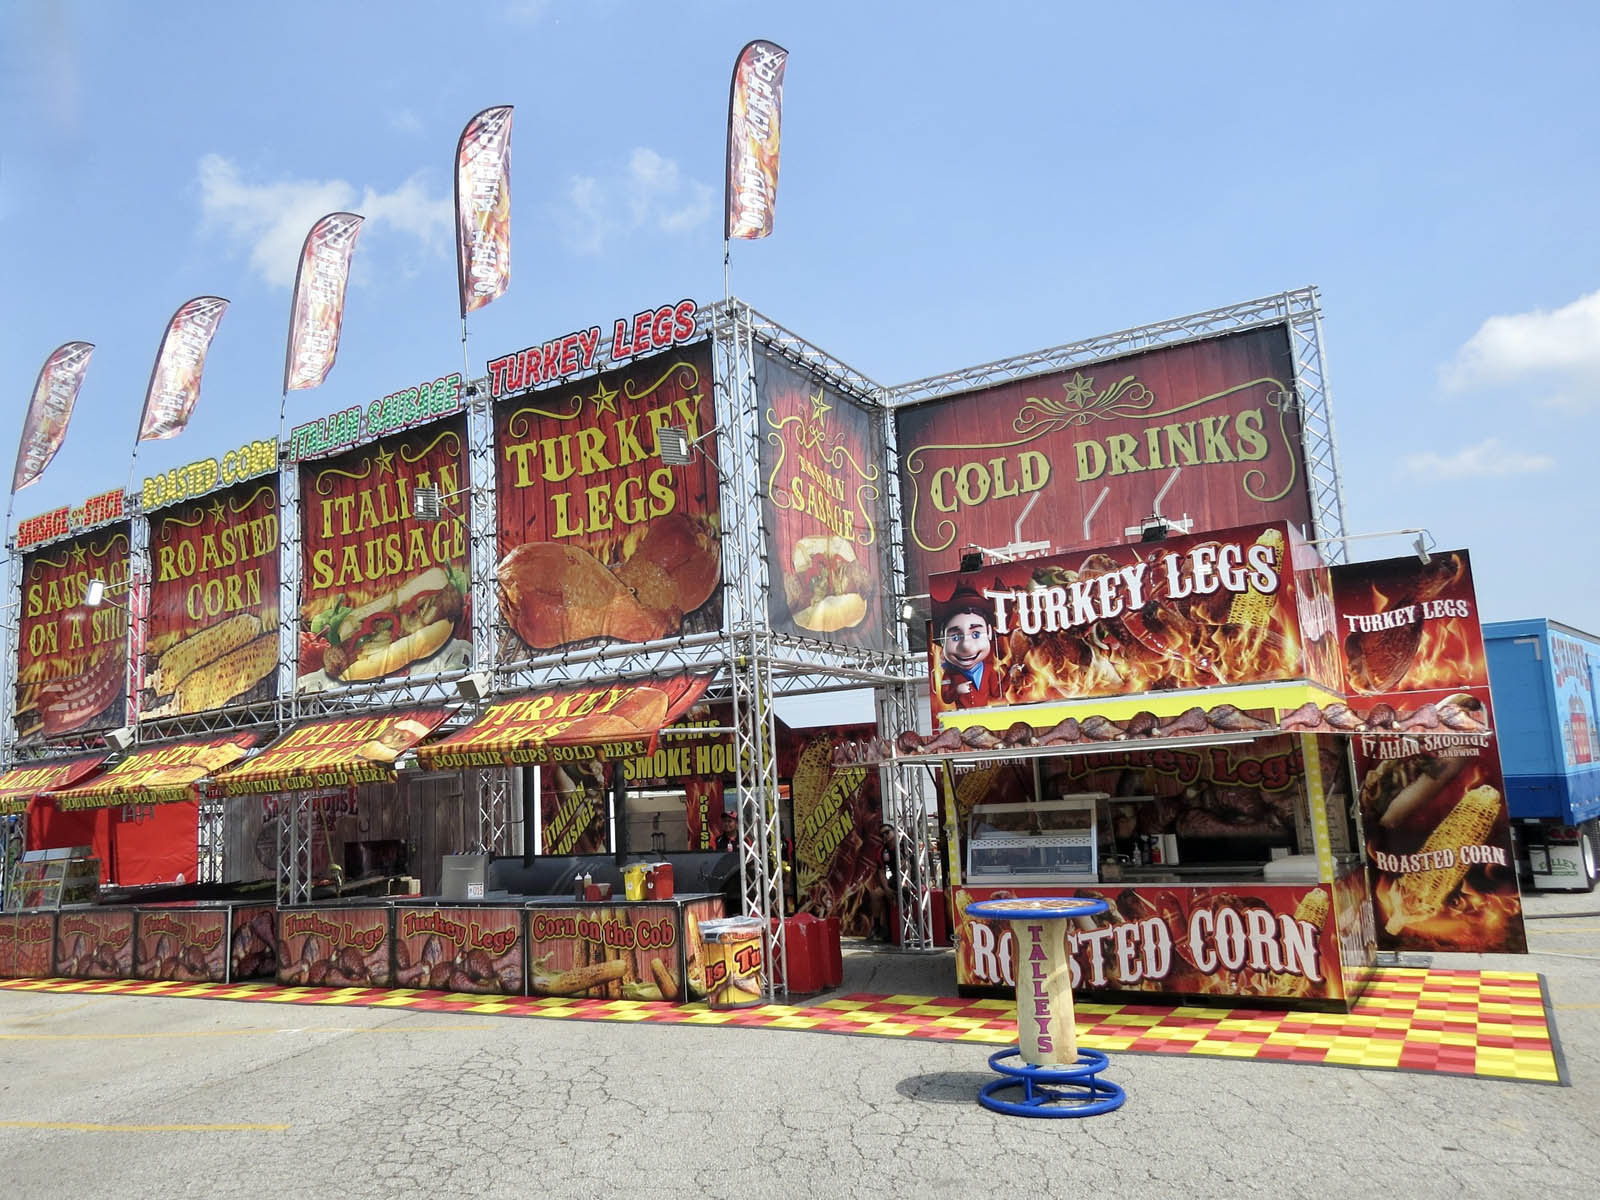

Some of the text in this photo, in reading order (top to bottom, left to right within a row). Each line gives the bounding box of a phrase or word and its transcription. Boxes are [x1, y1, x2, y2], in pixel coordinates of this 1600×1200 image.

[488, 299, 697, 398] TURKEY LEGS
[290, 373, 462, 462] ITALIAN SAUSAGE
[505, 394, 704, 488] TURKEY
[142, 438, 278, 510] ROASTED CORN
[930, 408, 1269, 513] COLD DRINKS
[17, 506, 70, 548] SAUSAGE
[84, 489, 124, 526] STICK
[551, 466, 676, 539] LEGS
[158, 513, 279, 582] ROASTED
[312, 515, 465, 590] SAUSAGE
[186, 568, 262, 621] CORN
[983, 543, 1279, 635] TURKEY LEGS
[1343, 599, 1470, 634] TURKEY LEGS
[29, 621, 58, 657] ON
[69, 616, 84, 649] A
[274, 717, 400, 750] ITALIAN
[433, 741, 646, 768] SOUVENIR CUPS SOLD HERE
[665, 719, 720, 742] TOM'S
[1438, 748, 1480, 758] SANDWICH
[227, 778, 281, 795] SOUVENIR
[285, 775, 312, 790] CUPS
[318, 772, 347, 787] SOLD
[354, 768, 387, 783] HERE
[623, 747, 691, 781] SMOKE
[63, 789, 185, 810] SOUVENIR CUP SOLD HERE
[552, 799, 596, 855] AUSAGE
[700, 795, 709, 850] POLISH
[805, 767, 868, 837] ROASTED
[815, 809, 854, 864] CORN
[1375, 844, 1507, 874] ROASTED CORN
[191, 924, 222, 950] Legs
[286, 913, 384, 950] Turkey Legs
[404, 912, 516, 953] Turkey Legs
[533, 914, 674, 948] Corn on the Cob
[971, 916, 1172, 988] ROSTED
[1187, 906, 1324, 983] CORN
[1028, 925, 1053, 1054] TALLEYS
